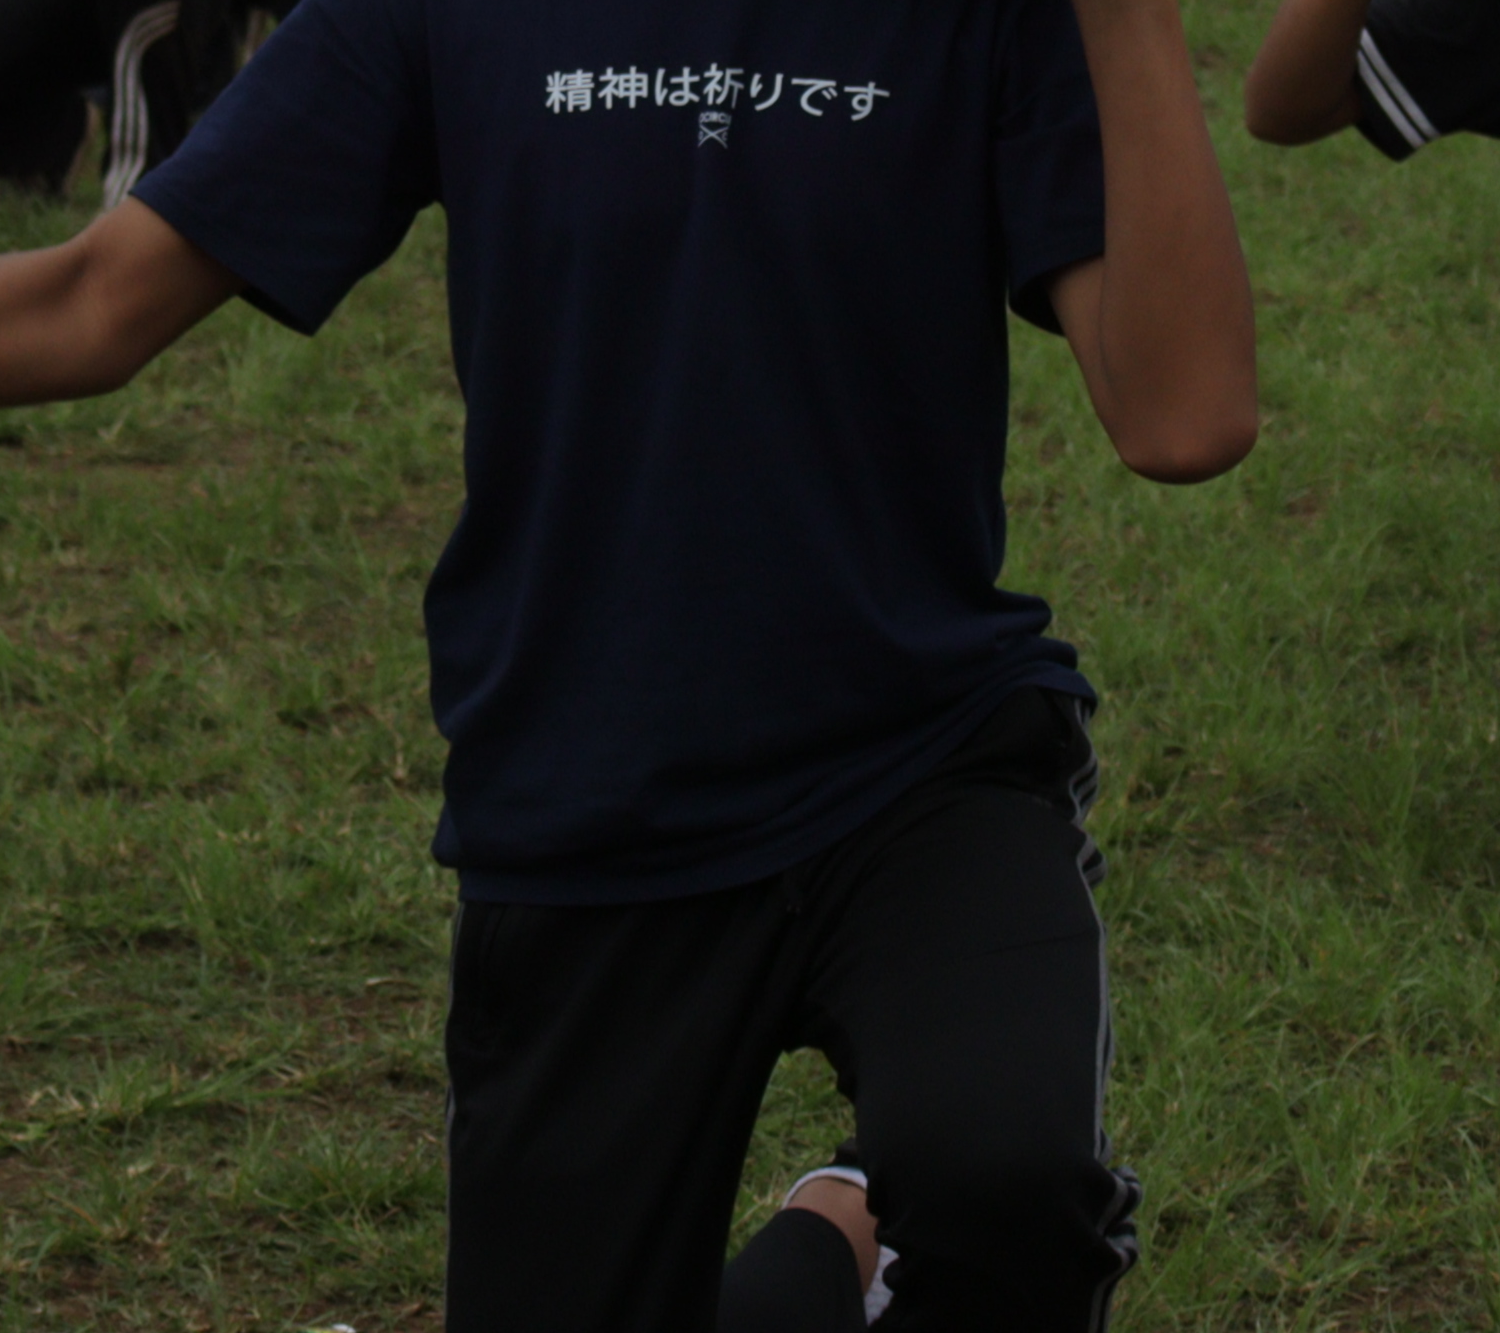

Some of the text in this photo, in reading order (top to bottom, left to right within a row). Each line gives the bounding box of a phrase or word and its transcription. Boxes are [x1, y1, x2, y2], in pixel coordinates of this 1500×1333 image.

[544, 61, 891, 122] 精神は祈りです
